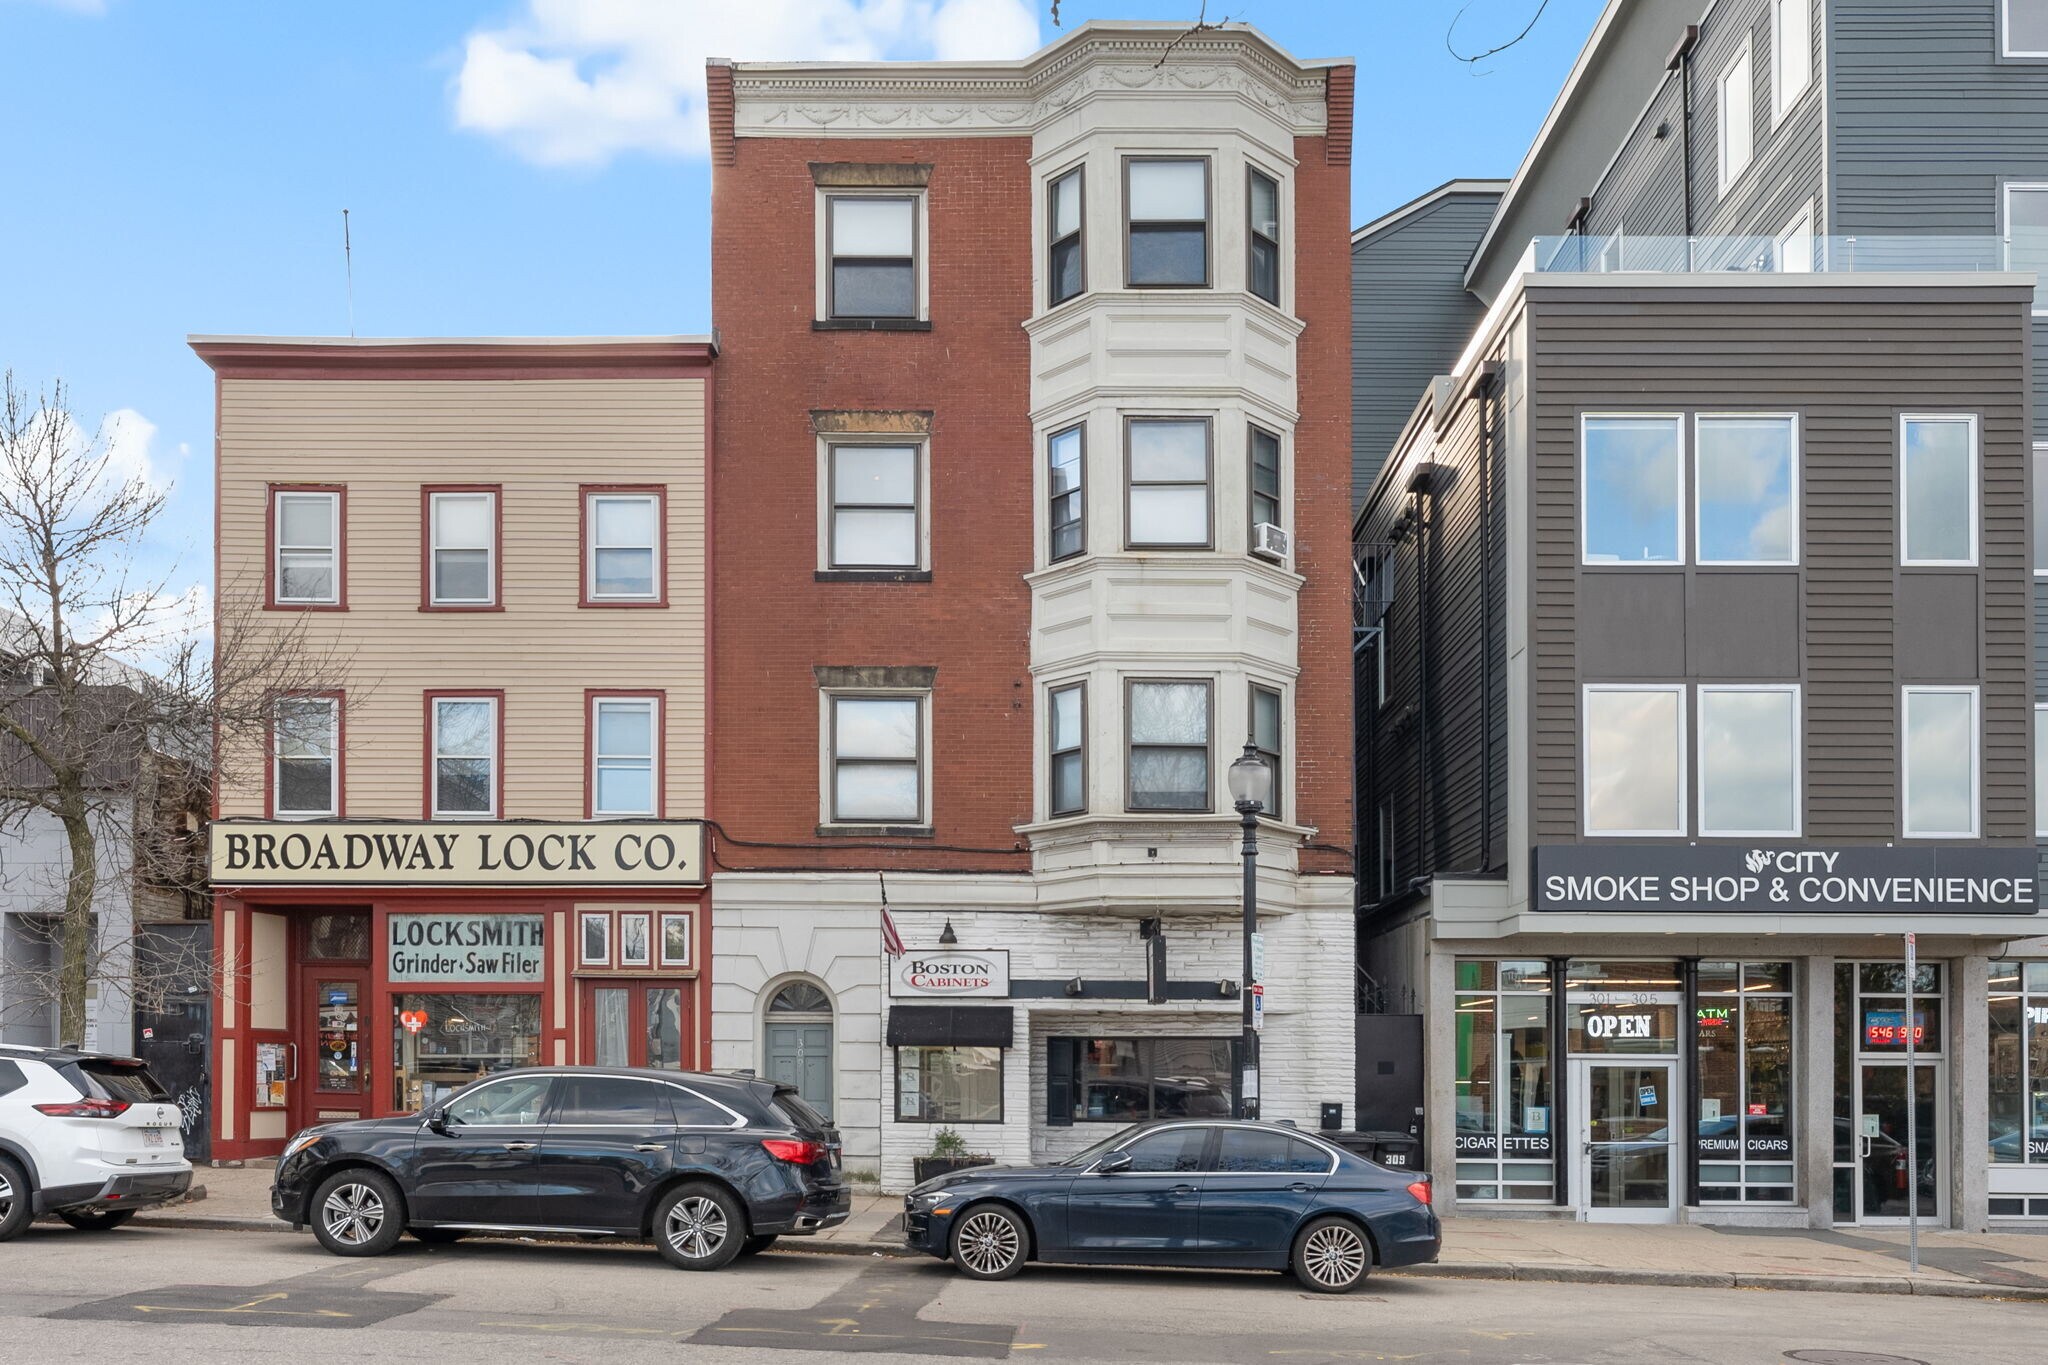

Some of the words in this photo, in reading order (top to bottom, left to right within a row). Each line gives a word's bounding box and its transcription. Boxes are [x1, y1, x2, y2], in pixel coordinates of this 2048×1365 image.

[224, 833, 460, 870] BROADWAY
[478, 833, 597, 871] LOCK
[614, 833, 687, 871] CO.
[1775, 851, 1840, 873] CITY
[1545, 875, 1660, 902] SMOKE
[1669, 876, 1760, 902] SHOP
[1768, 876, 1791, 903] &
[1799, 877, 2034, 903] CONVENIENCE
[392, 920, 544, 947] LOCKSMITH
[392, 951, 457, 974] Grinder
[465, 951, 499, 974] Saw
[502, 951, 540, 974] Filer
[911, 960, 989, 975] BOSTON
[910, 974, 990, 988] CABINETS
[1589, 992, 1610, 1004] 301
[1631, 993, 1658, 1005] 305
[1696, 1009, 1728, 1018] ATM
[1587, 1015, 1652, 1038] OPEN
[1871, 1026, 1893, 1038] 546
[1899, 1026, 1922, 1038] 90
[1698, 1139, 1739, 1150] REMIUM
[1747, 1139, 1789, 1150] CIGARS
[1385, 1154, 1406, 1165] 309
